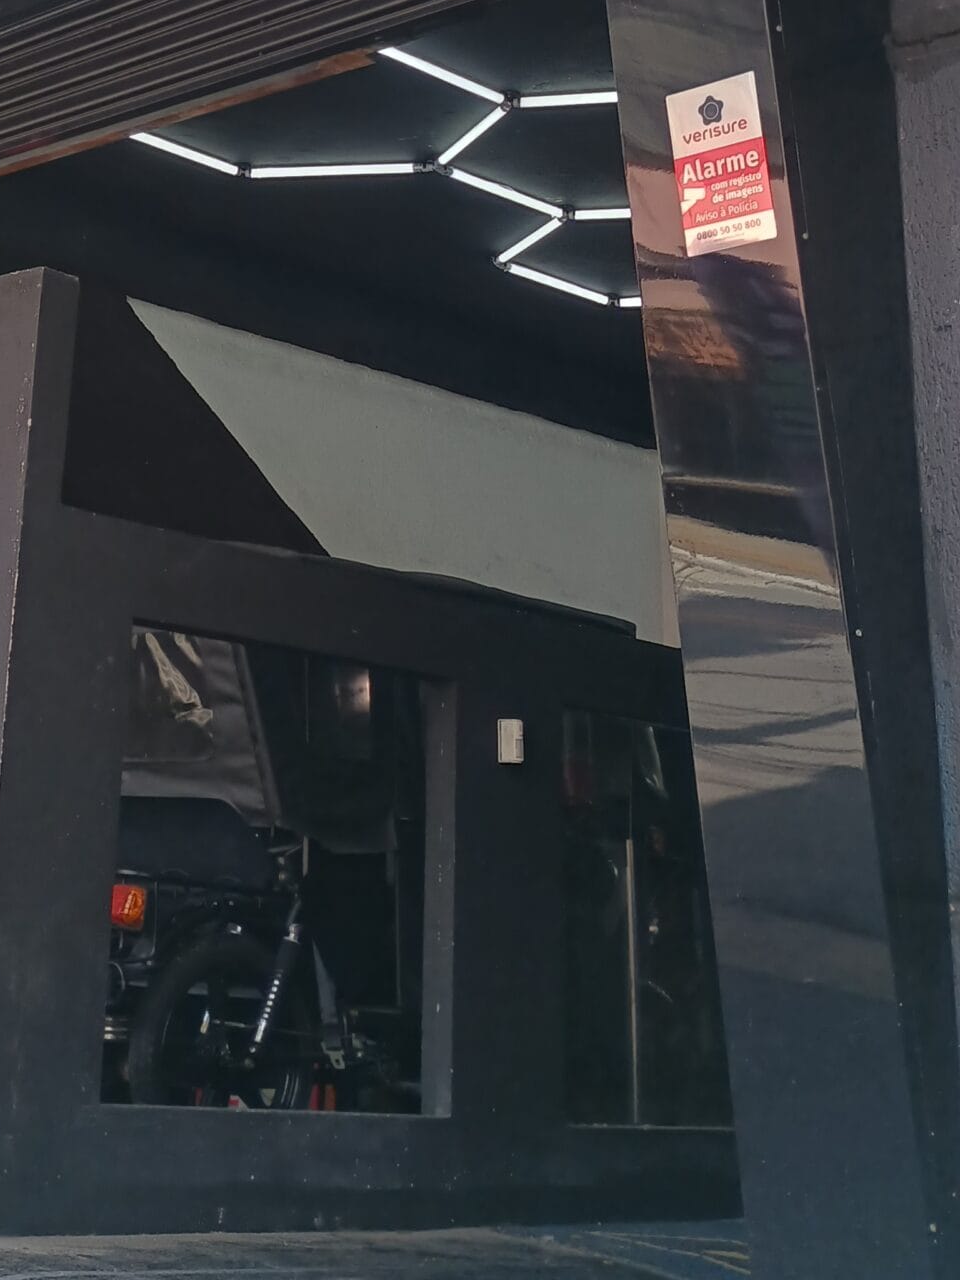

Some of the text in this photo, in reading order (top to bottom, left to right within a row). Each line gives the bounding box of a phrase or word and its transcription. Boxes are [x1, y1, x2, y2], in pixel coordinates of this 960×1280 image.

[683, 118, 747, 144] verisure
[683, 150, 759, 184] Alarme
[711, 172, 762, 191] com registro
[712, 184, 763, 203] de imagens
[695, 210, 718, 223] Aviso
